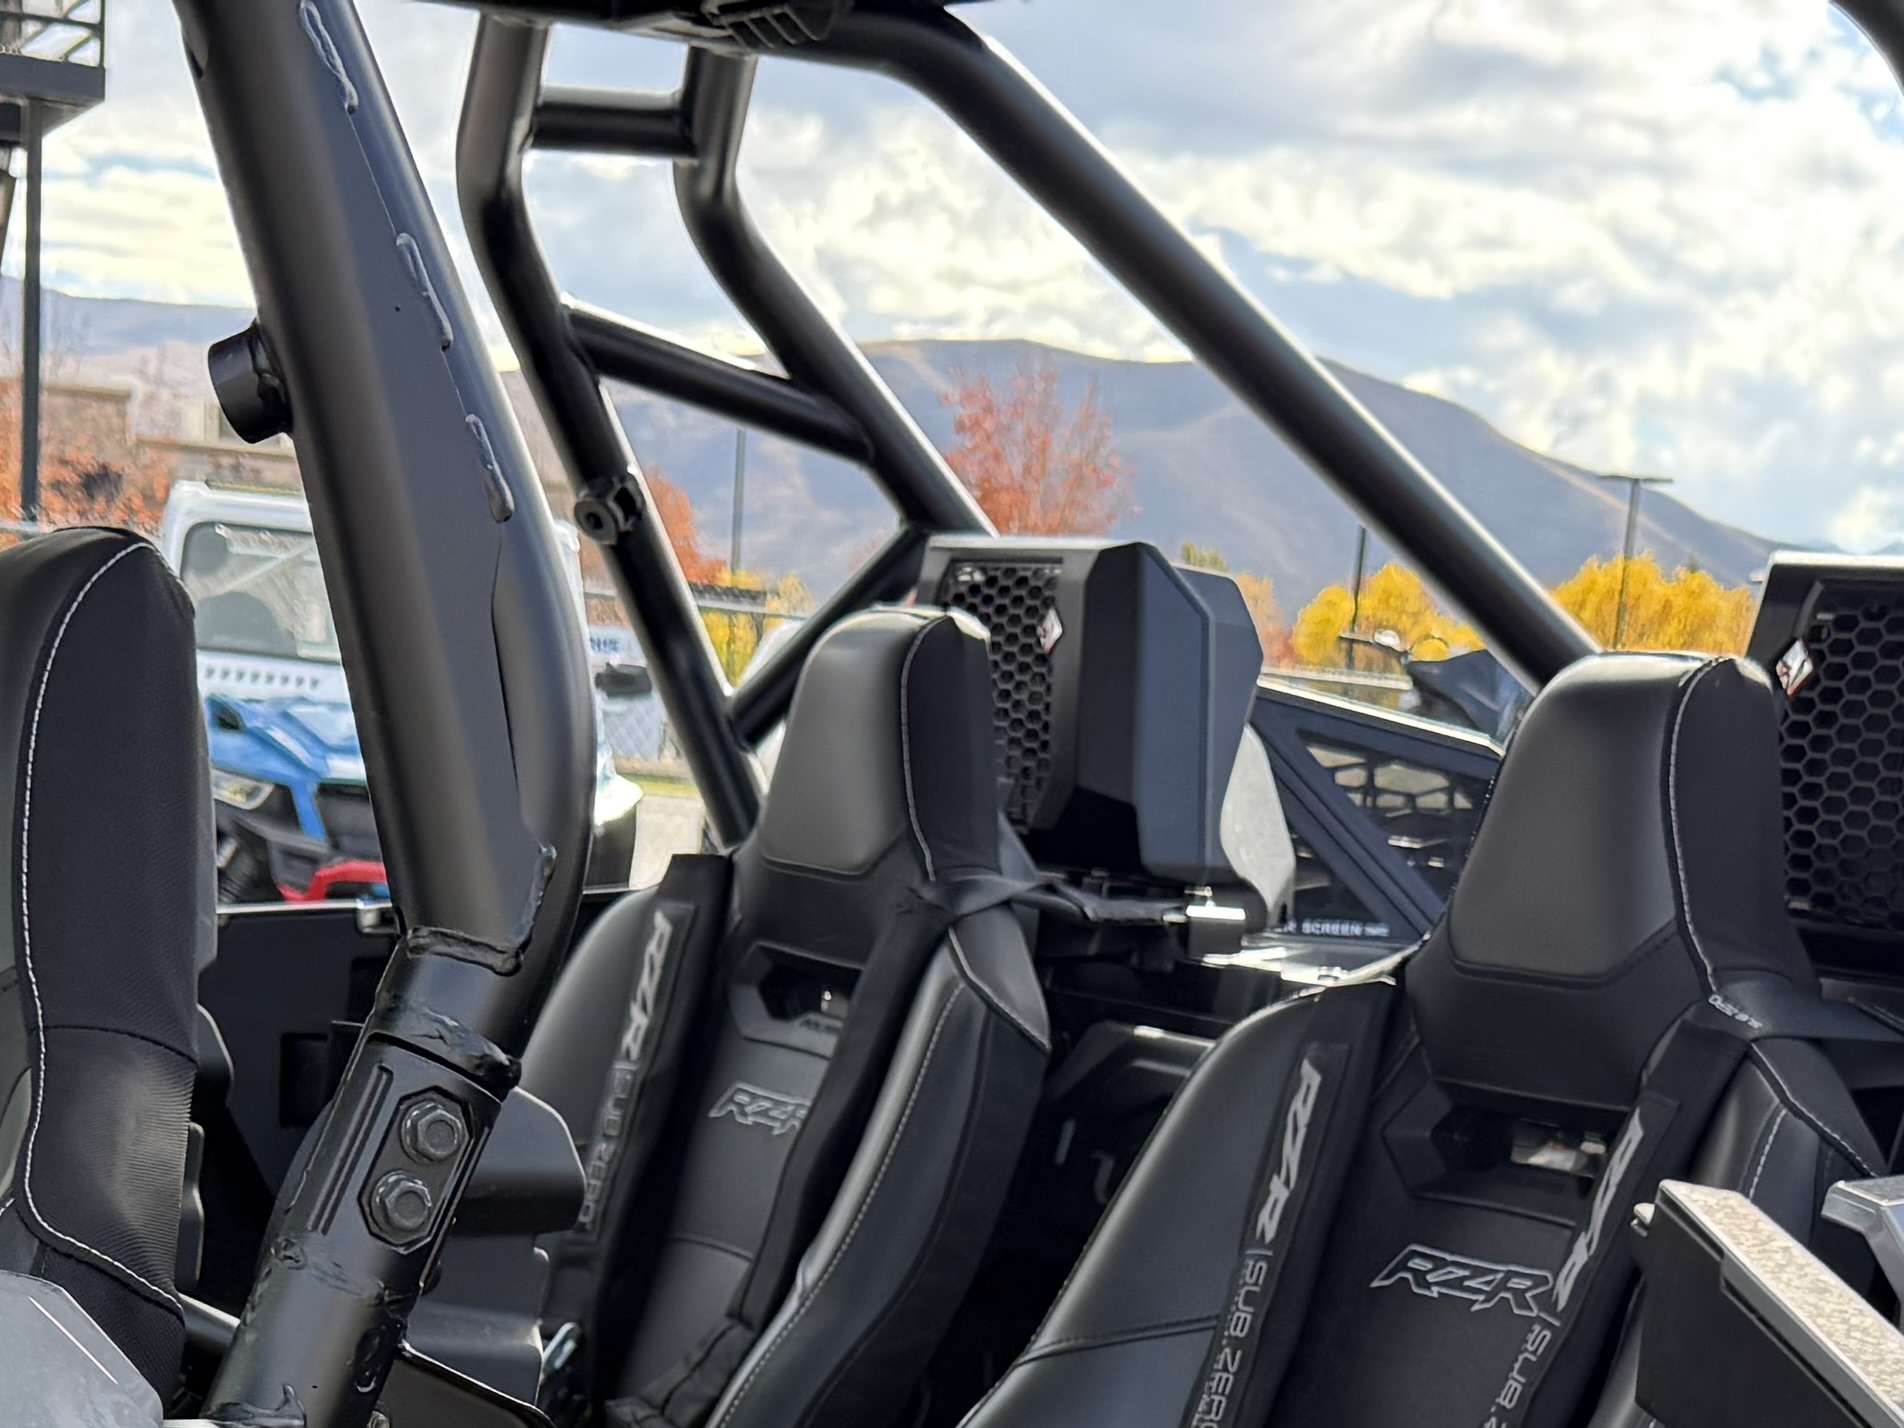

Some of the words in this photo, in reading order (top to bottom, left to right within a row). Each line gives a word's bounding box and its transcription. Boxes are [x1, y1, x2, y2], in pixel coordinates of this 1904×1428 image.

[1301, 918, 1362, 936] SCREEN
[621, 909, 673, 1061] RZR
[1256, 1057, 1322, 1244] RZR
[1229, 1259, 1269, 1339] SUB
[1369, 1243, 1556, 1317] RZR
[1496, 1327, 1552, 1410] SUB
